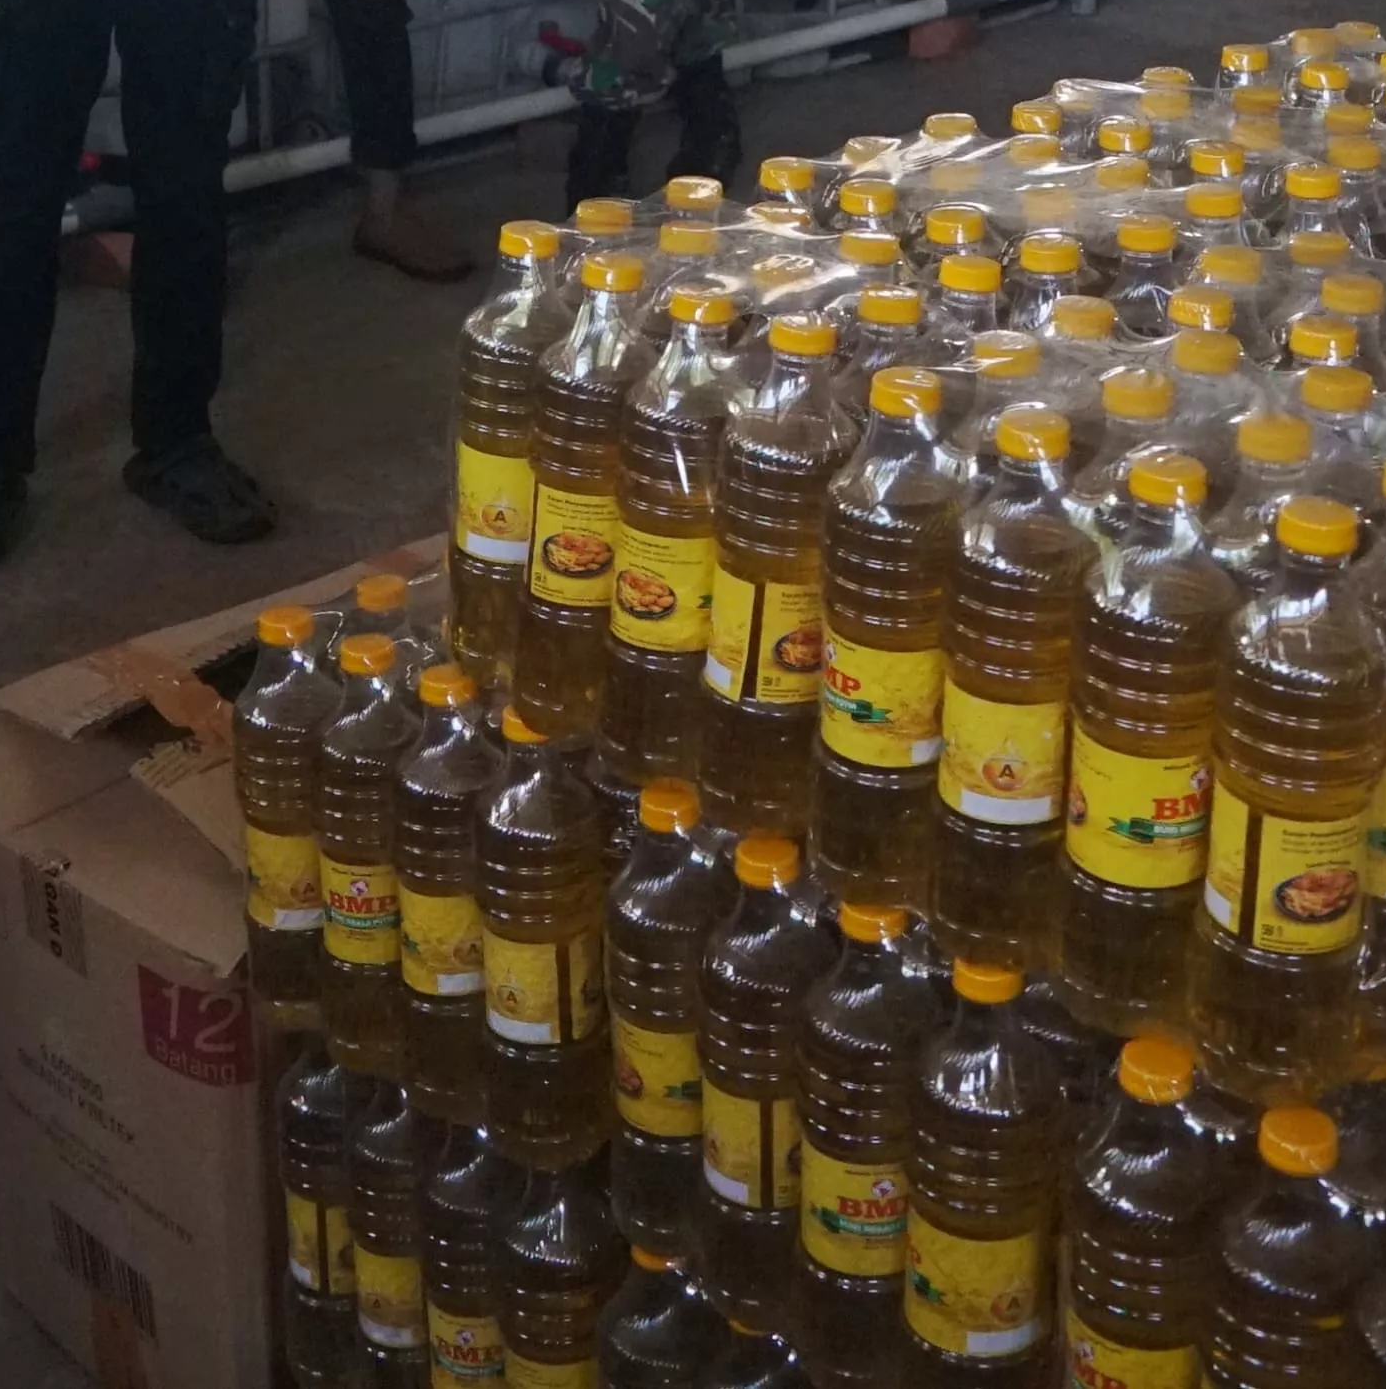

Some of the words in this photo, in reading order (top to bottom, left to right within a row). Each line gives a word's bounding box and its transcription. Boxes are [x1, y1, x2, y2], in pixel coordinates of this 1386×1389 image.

[824, 664, 862, 697] MP
[1151, 789, 1210, 821] BM
[329, 890, 398, 915] BMP
[162, 983, 245, 1053] 12
[155, 1037, 238, 1083] Batang
